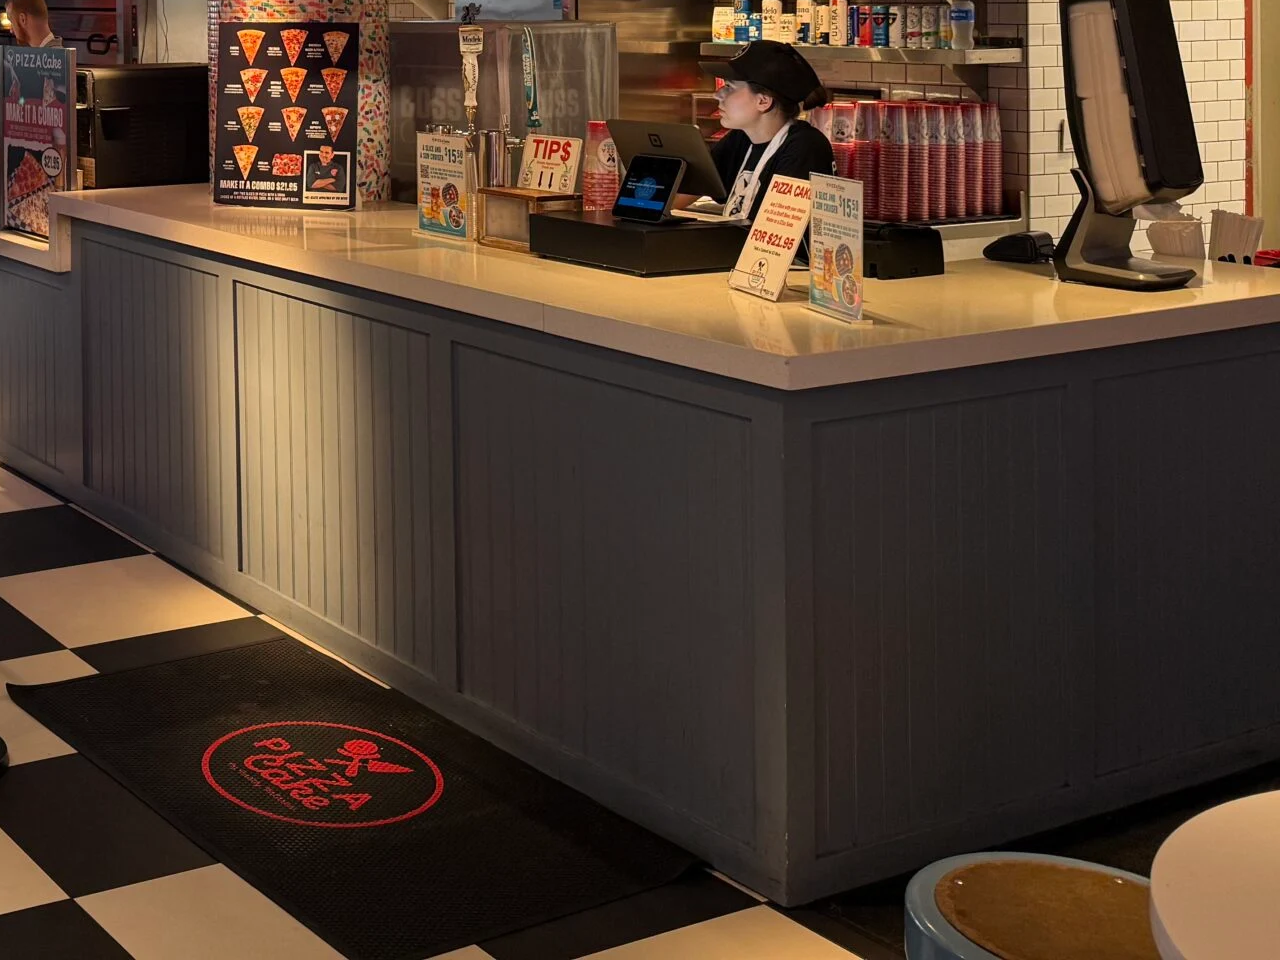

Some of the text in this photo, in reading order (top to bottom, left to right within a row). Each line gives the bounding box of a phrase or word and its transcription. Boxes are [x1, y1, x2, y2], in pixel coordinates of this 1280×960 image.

[831, 8, 839, 37] ULTRA
[15, 53, 63, 69] PIZZA Cake
[6, 103, 64, 128] MAKE IT A COMBO
[43, 155, 60, 171] $21.95
[220, 180, 238, 189] MAKE
[239, 180, 245, 189] IT
[245, 181, 251, 189] A
[251, 181, 275, 191] COMBO
[771, 181, 793, 196] PIZZA
[751, 228, 795, 250] FOR $21.95
[254, 738, 372, 811] PIZZA
